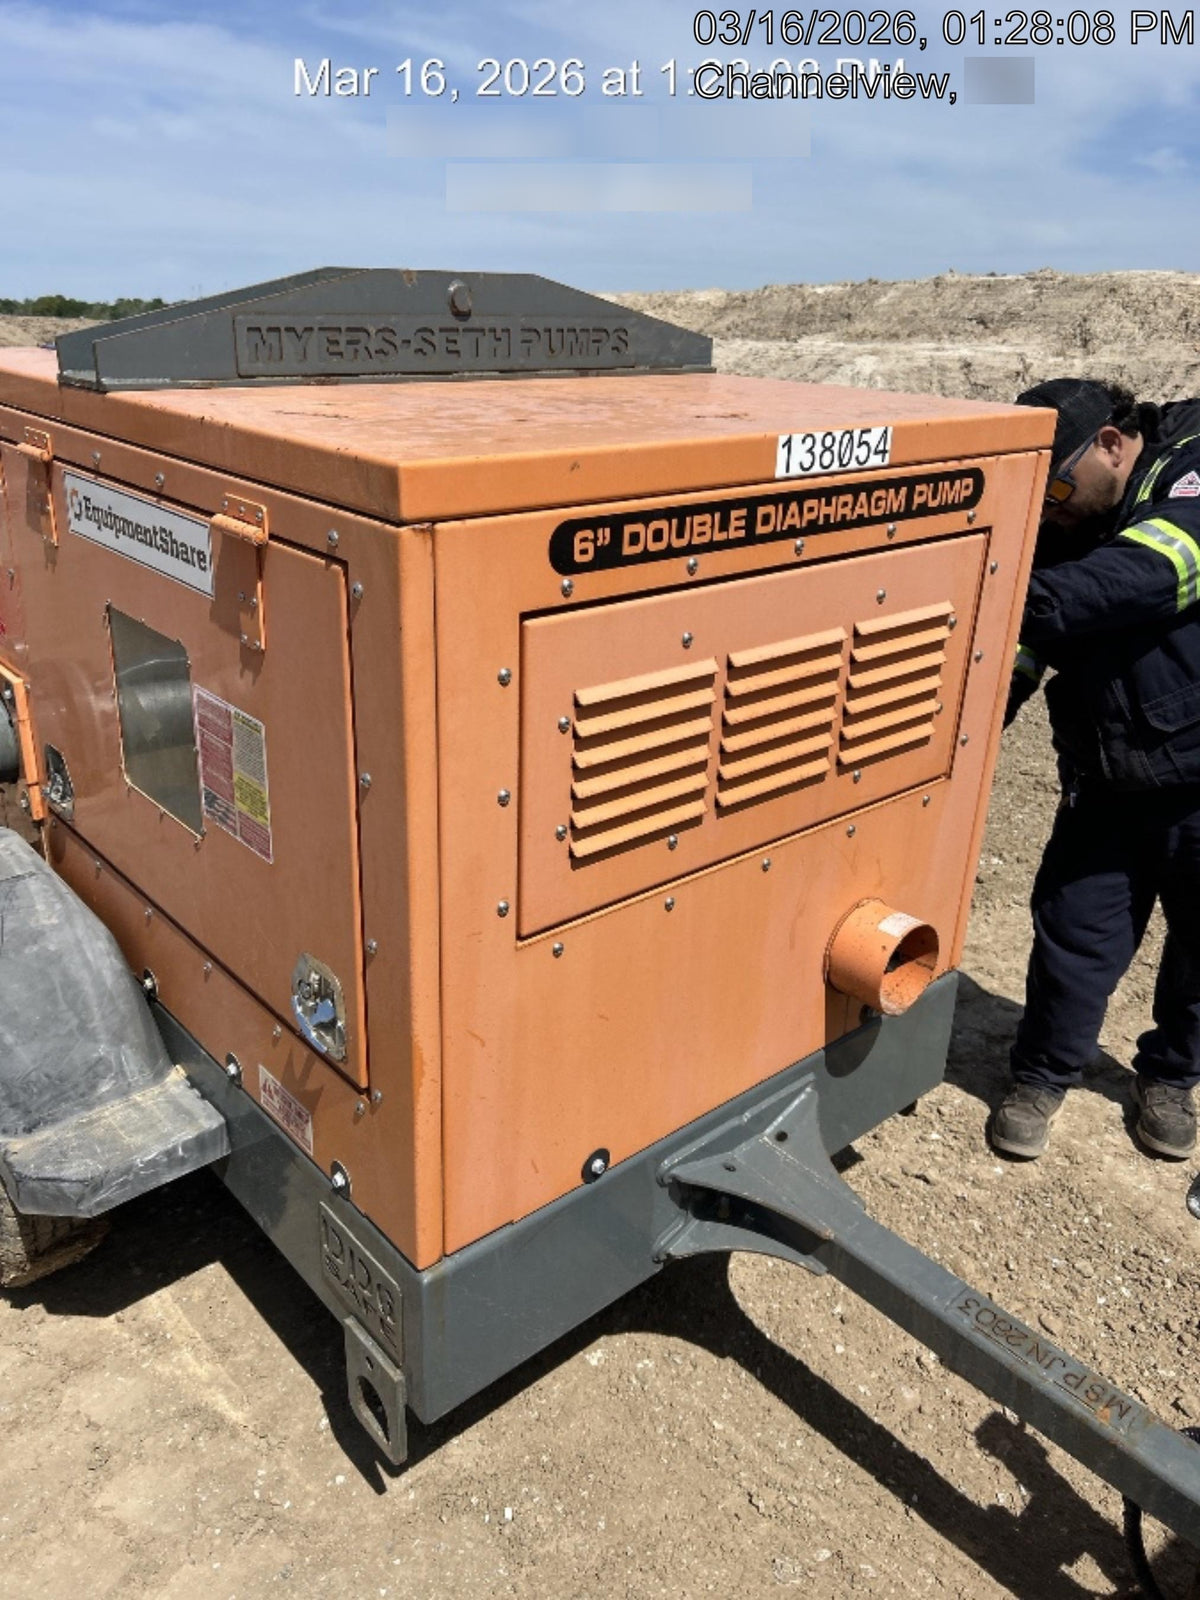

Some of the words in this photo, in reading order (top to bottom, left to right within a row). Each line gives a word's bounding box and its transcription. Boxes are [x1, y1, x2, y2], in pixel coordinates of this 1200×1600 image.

[246, 326, 512, 363] MYERS-SETH
[520, 326, 629, 357] PUMPS
[780, 427, 890, 474] 138054
[82, 495, 208, 572] EquipmentShare
[621, 507, 747, 556] DOUBLE
[755, 484, 907, 533] DIAPHRAGM
[911, 477, 974, 511] PUMP
[1026, 1341, 1067, 1371] JN
[1062, 1371, 1133, 1420] MSP
